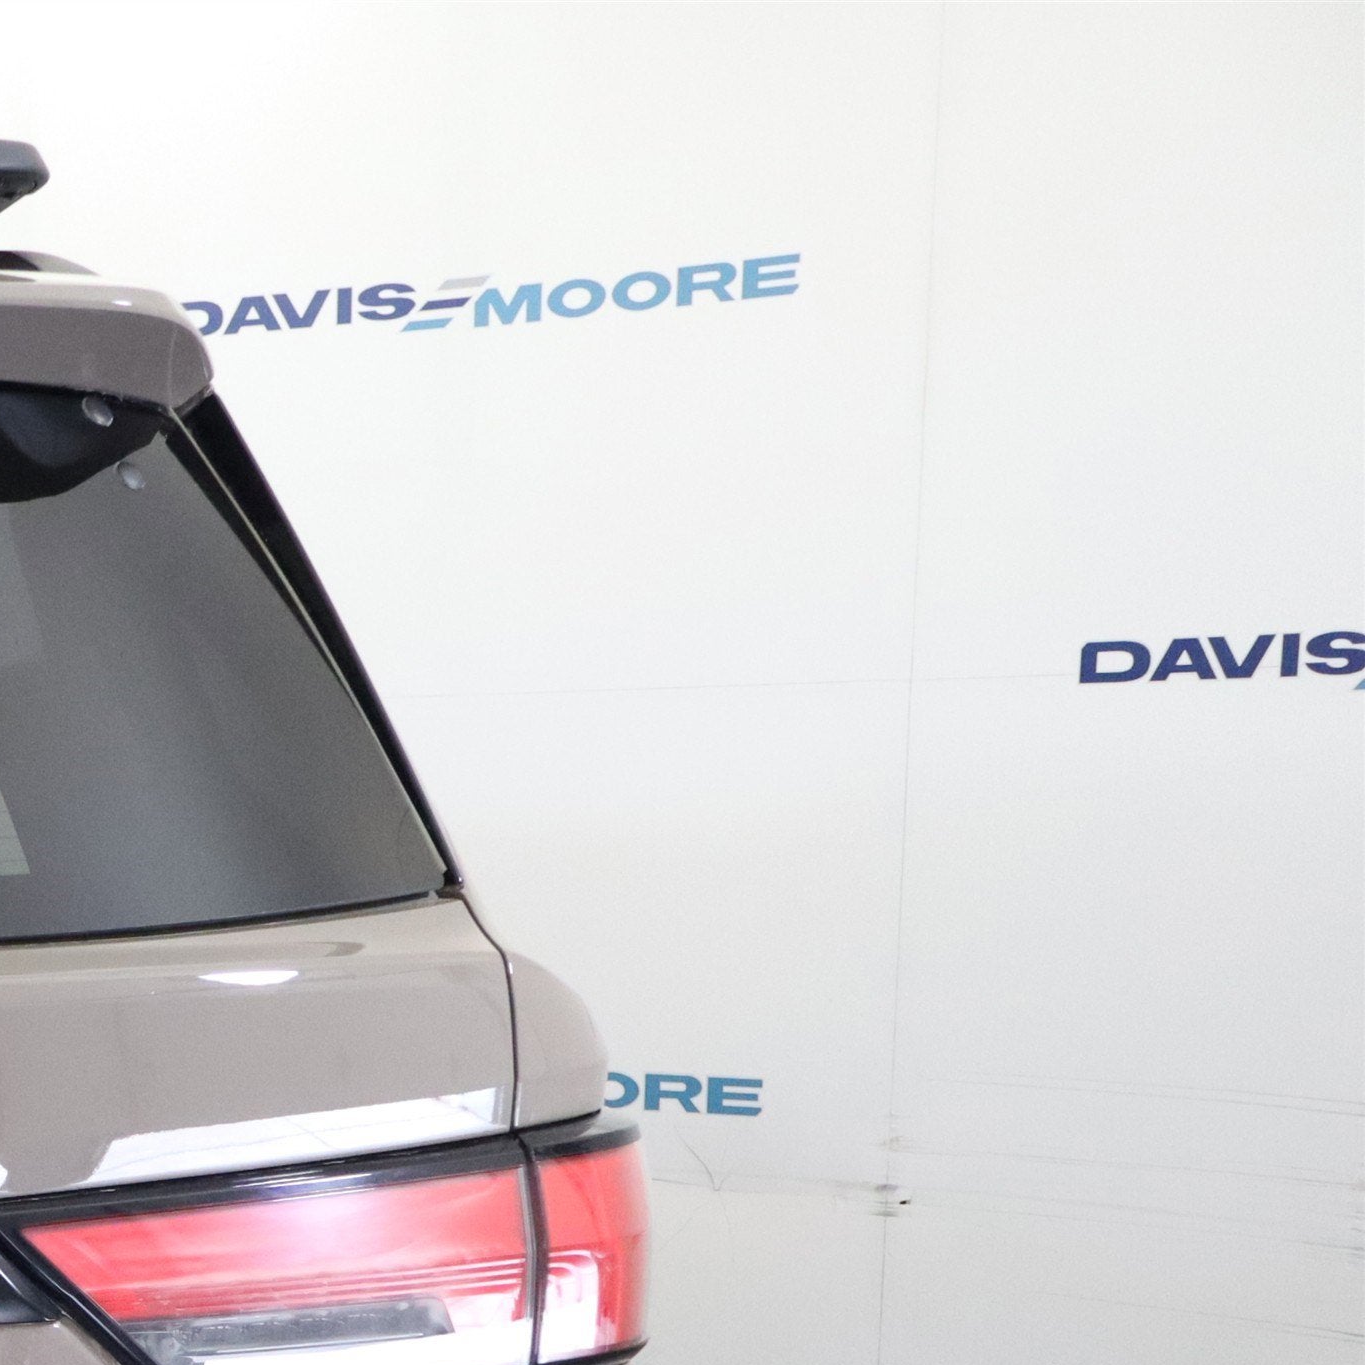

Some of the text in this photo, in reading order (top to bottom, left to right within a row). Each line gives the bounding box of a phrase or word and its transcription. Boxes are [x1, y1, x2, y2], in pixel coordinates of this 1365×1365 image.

[181, 253, 801, 336] DAVIS MOORE
[1078, 631, 1365, 684] DAVIS
